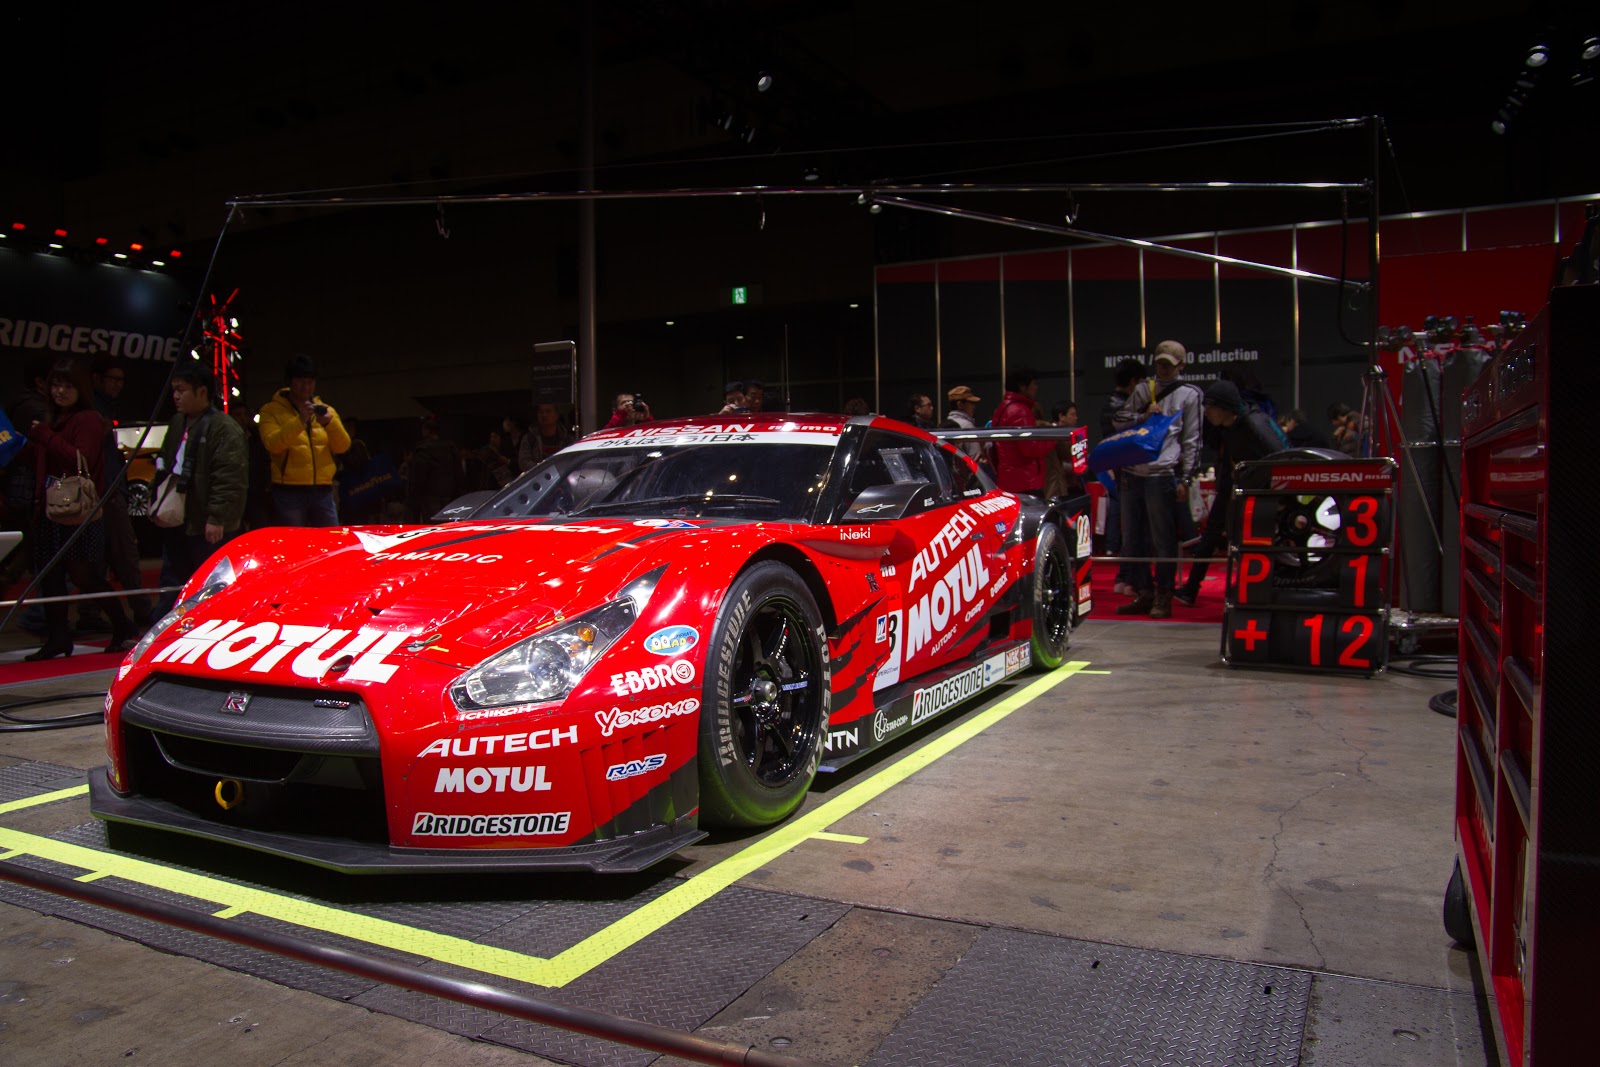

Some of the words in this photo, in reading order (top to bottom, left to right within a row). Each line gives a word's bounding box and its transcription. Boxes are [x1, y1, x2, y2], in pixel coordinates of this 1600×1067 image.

[1105, 354, 1146, 368] NIN
[1200, 348, 1259, 363] collection
[624, 423, 755, 437] NISSAN
[768, 424, 837, 432] nsmo
[1303, 472, 1364, 483] NISSAN
[1242, 496, 1273, 546] L
[1346, 496, 1379, 547] 3
[366, 552, 504, 564] TAMADIC
[908, 508, 978, 594] AUTECH
[1238, 553, 1272, 604] P
[1347, 555, 1369, 607] 1
[905, 542, 990, 663] MOTUL
[151, 619, 412, 684] MOTUL
[610, 660, 696, 697] EBBRO
[717, 589, 752, 768] BRIDGESTONE
[912, 667, 983, 724] BRIDGESTONE
[459, 705, 536, 721] ICHIKOH
[595, 698, 700, 736] YOKOMO
[806, 623, 832, 779] POTENZA
[417, 725, 578, 758] AUTECH
[825, 727, 859, 752] NTN
[434, 766, 552, 793] MOTUL
[608, 755, 665, 778] RAYS
[414, 813, 569, 835] BRIDGESTONE
